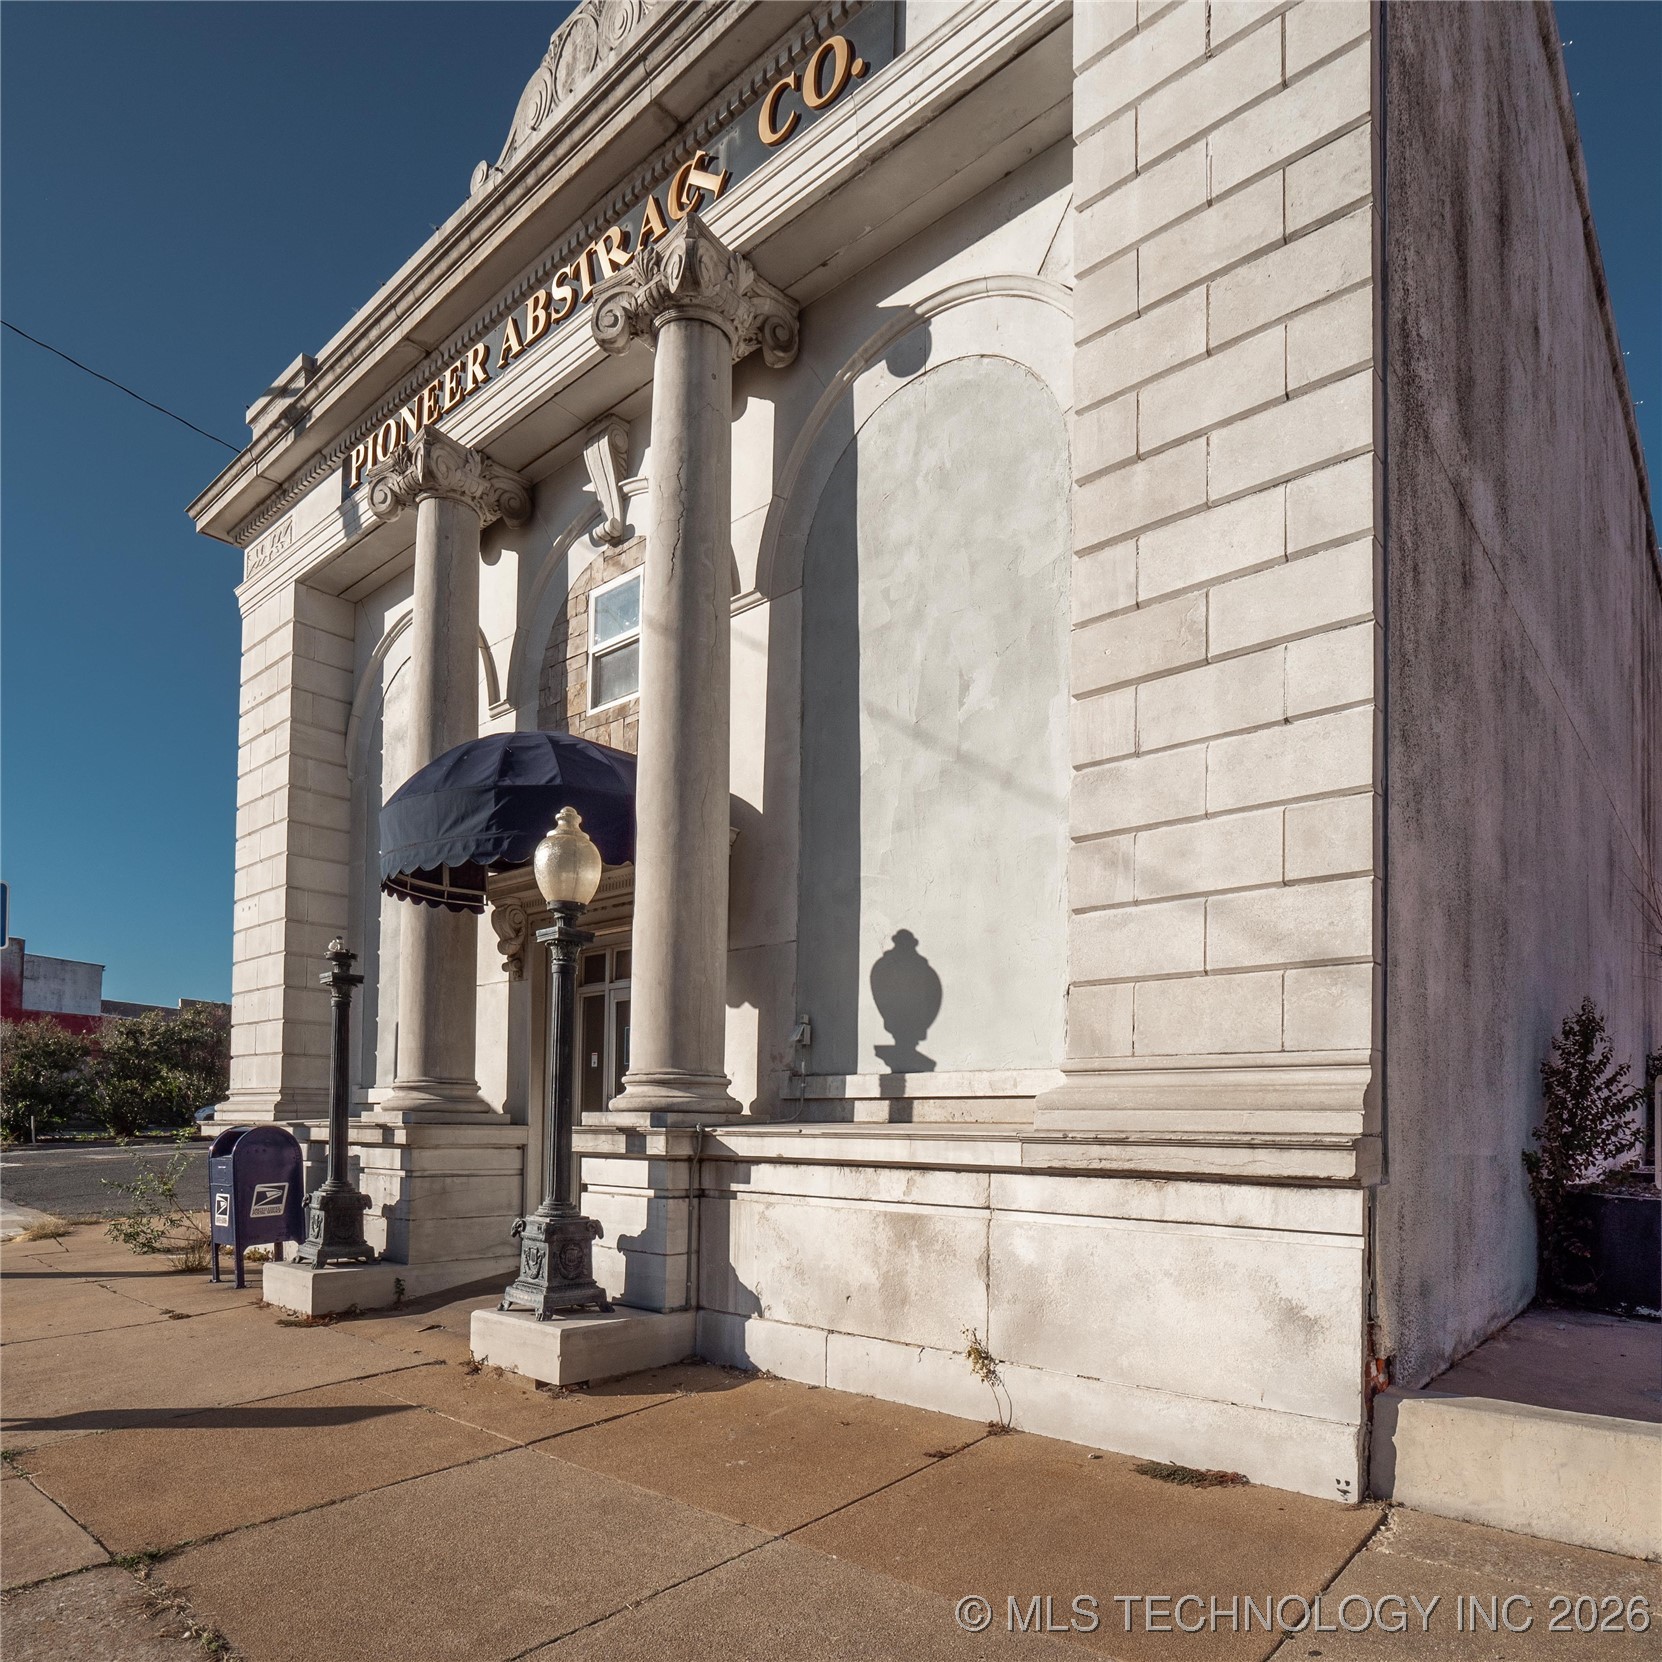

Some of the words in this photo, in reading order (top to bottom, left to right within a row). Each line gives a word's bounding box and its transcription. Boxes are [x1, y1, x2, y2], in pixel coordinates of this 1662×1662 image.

[350, 342, 490, 488] PIONEER
[497, 150, 729, 369] ABSTRACT
[758, 35, 867, 146] CO.
